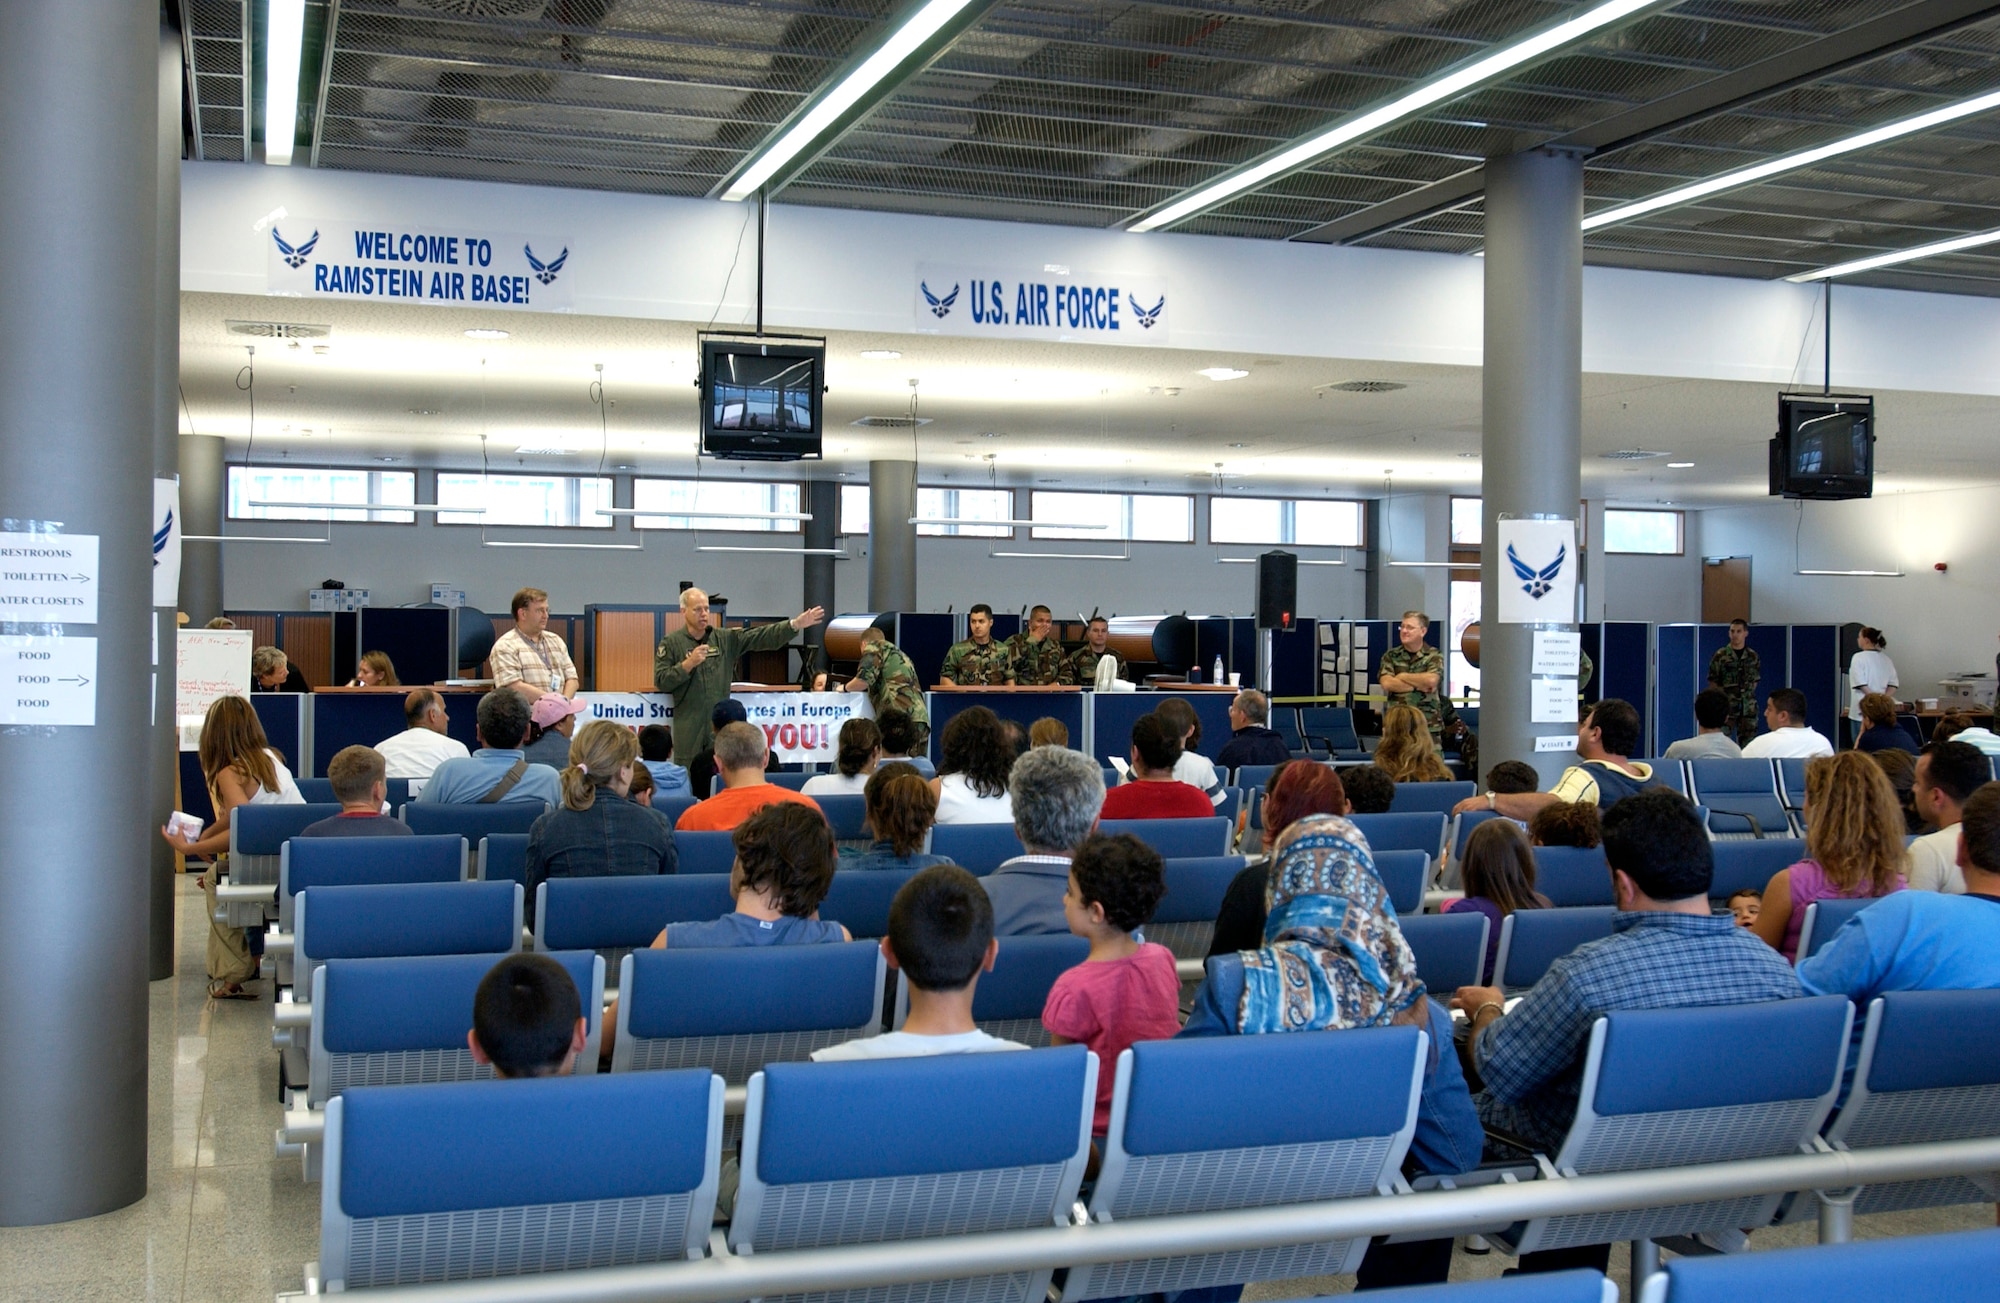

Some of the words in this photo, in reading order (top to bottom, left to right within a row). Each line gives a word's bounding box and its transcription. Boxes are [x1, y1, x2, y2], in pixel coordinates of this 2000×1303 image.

[355, 230, 458, 264] WELCOME
[465, 239, 492, 267] TO
[315, 264, 423, 298] RAMSTEIN
[430, 271, 465, 300] AIR
[472, 274, 530, 304] BASE!
[970, 280, 1009, 325] U.S.
[1015, 283, 1050, 326] AIR
[1056, 285, 1120, 330] FORCE
[0, 548, 72, 558] RESTROOMS
[3, 572, 68, 581] TOILETTEN
[31, 596, 84, 606] CLOSETS
[18, 651, 51, 660] FOOD
[18, 675, 50, 684] FOOD
[17, 698, 50, 707] FOOD
[593, 703, 644, 718] United
[782, 703, 796, 717] in
[801, 702, 851, 720] Europe
[762, 723, 829, 750] YOU!
